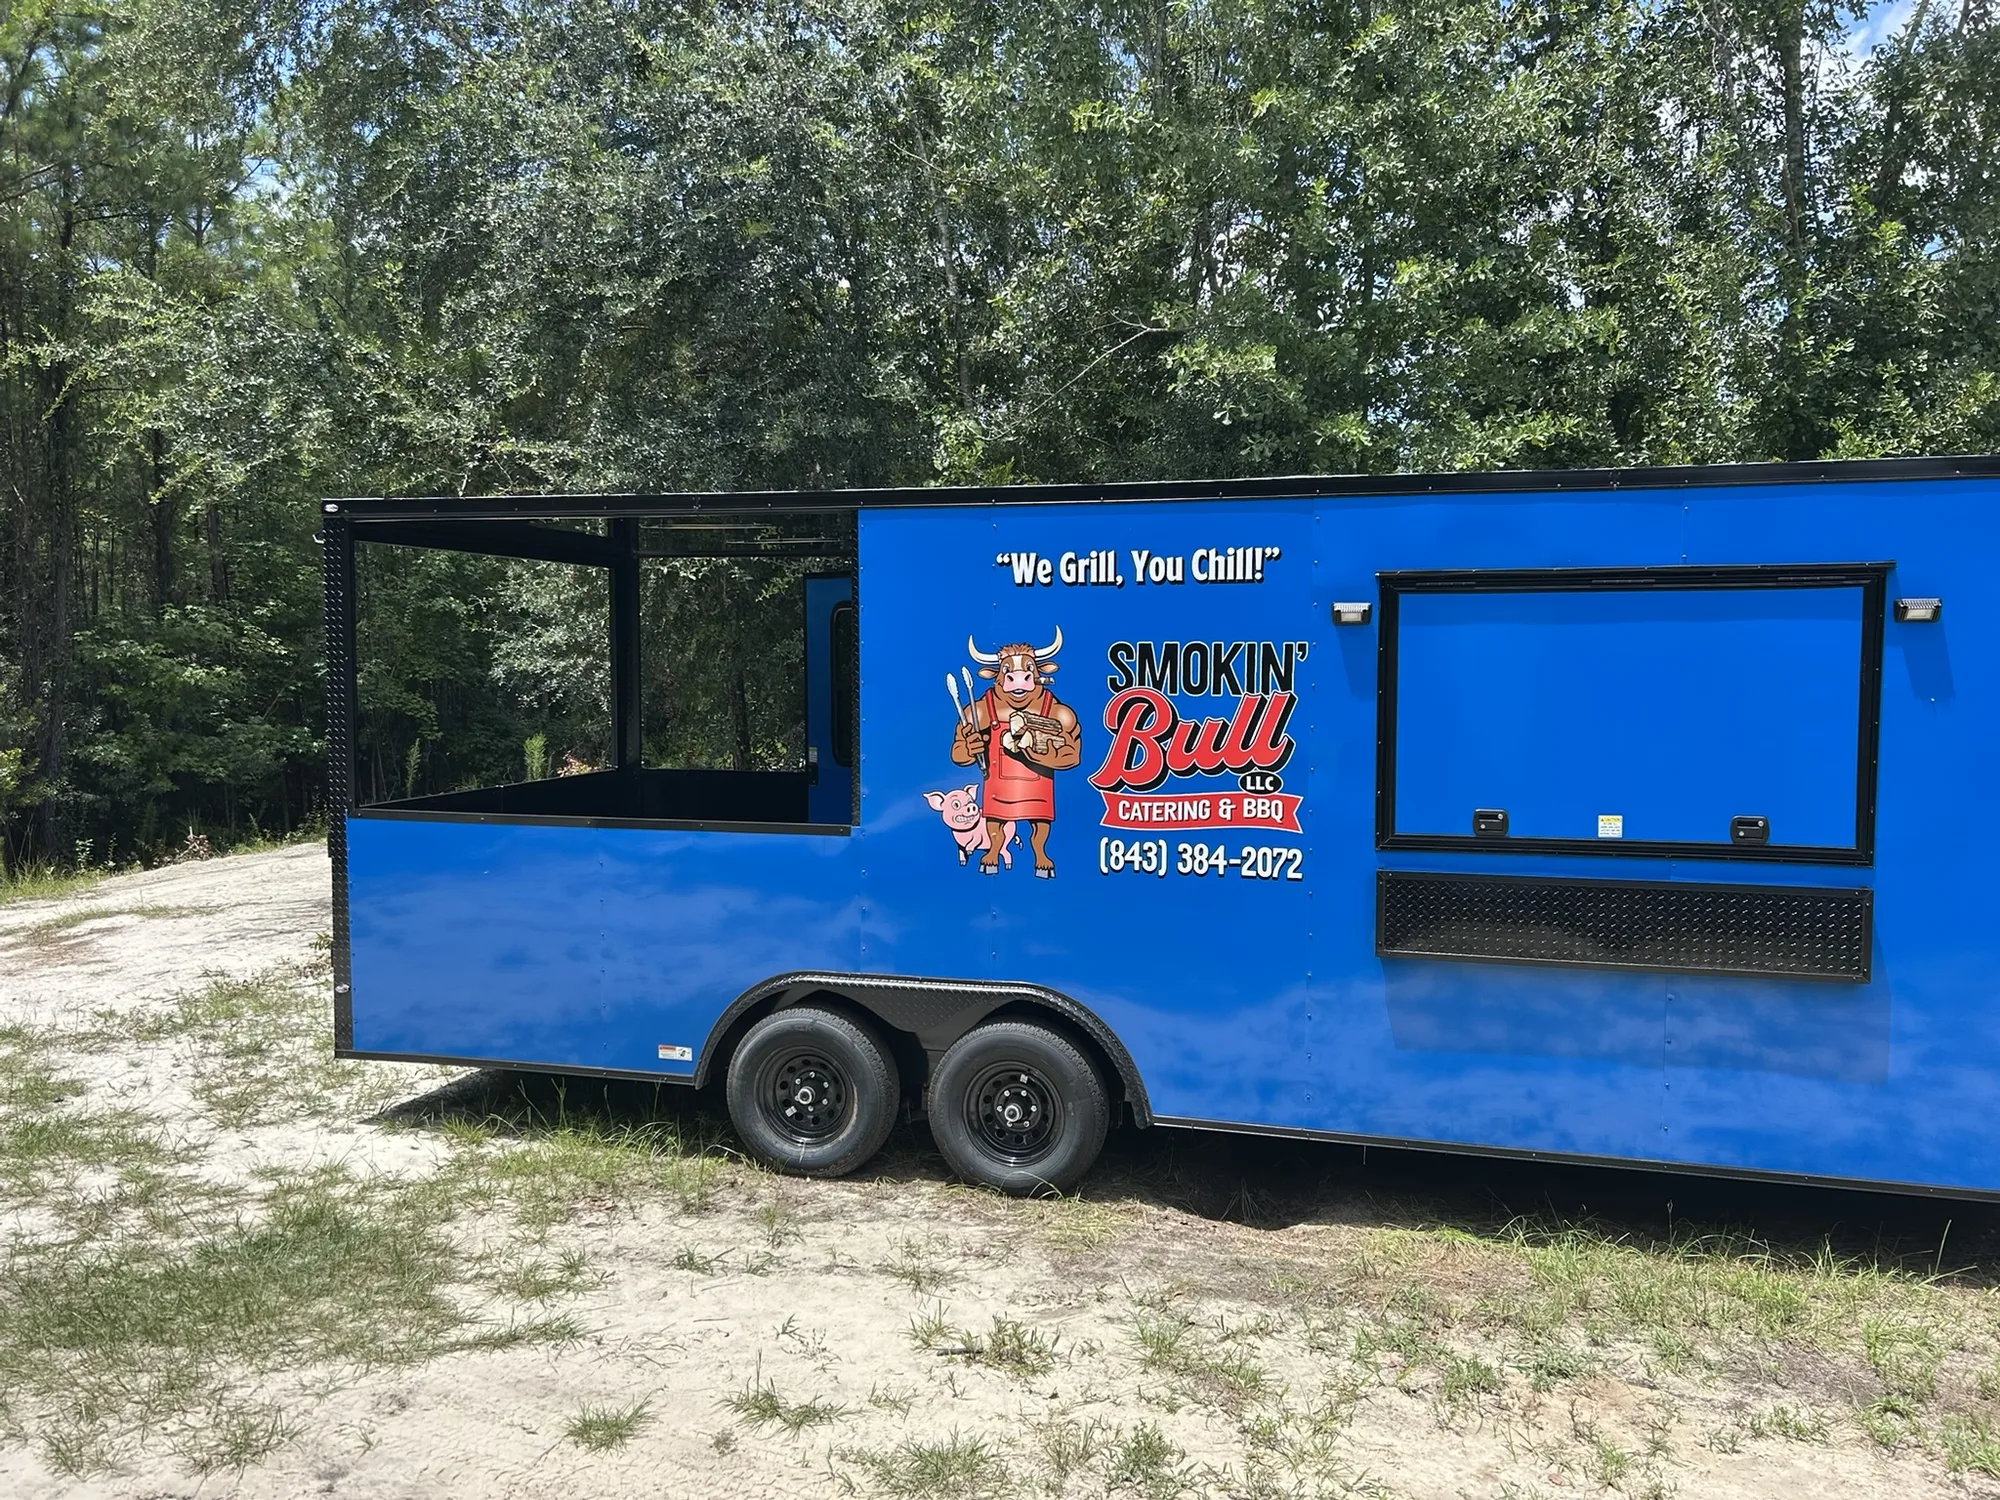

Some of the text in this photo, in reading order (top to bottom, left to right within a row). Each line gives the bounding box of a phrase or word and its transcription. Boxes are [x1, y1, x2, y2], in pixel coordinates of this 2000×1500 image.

[996, 547, 1281, 586] “We Grill, You Chill!”
[1088, 687, 1298, 793] Bull
[1245, 775, 1275, 792] LLC
[1118, 798, 1284, 823] CATERING & BBQ
[1099, 836, 1304, 880] (843) 384-2072
